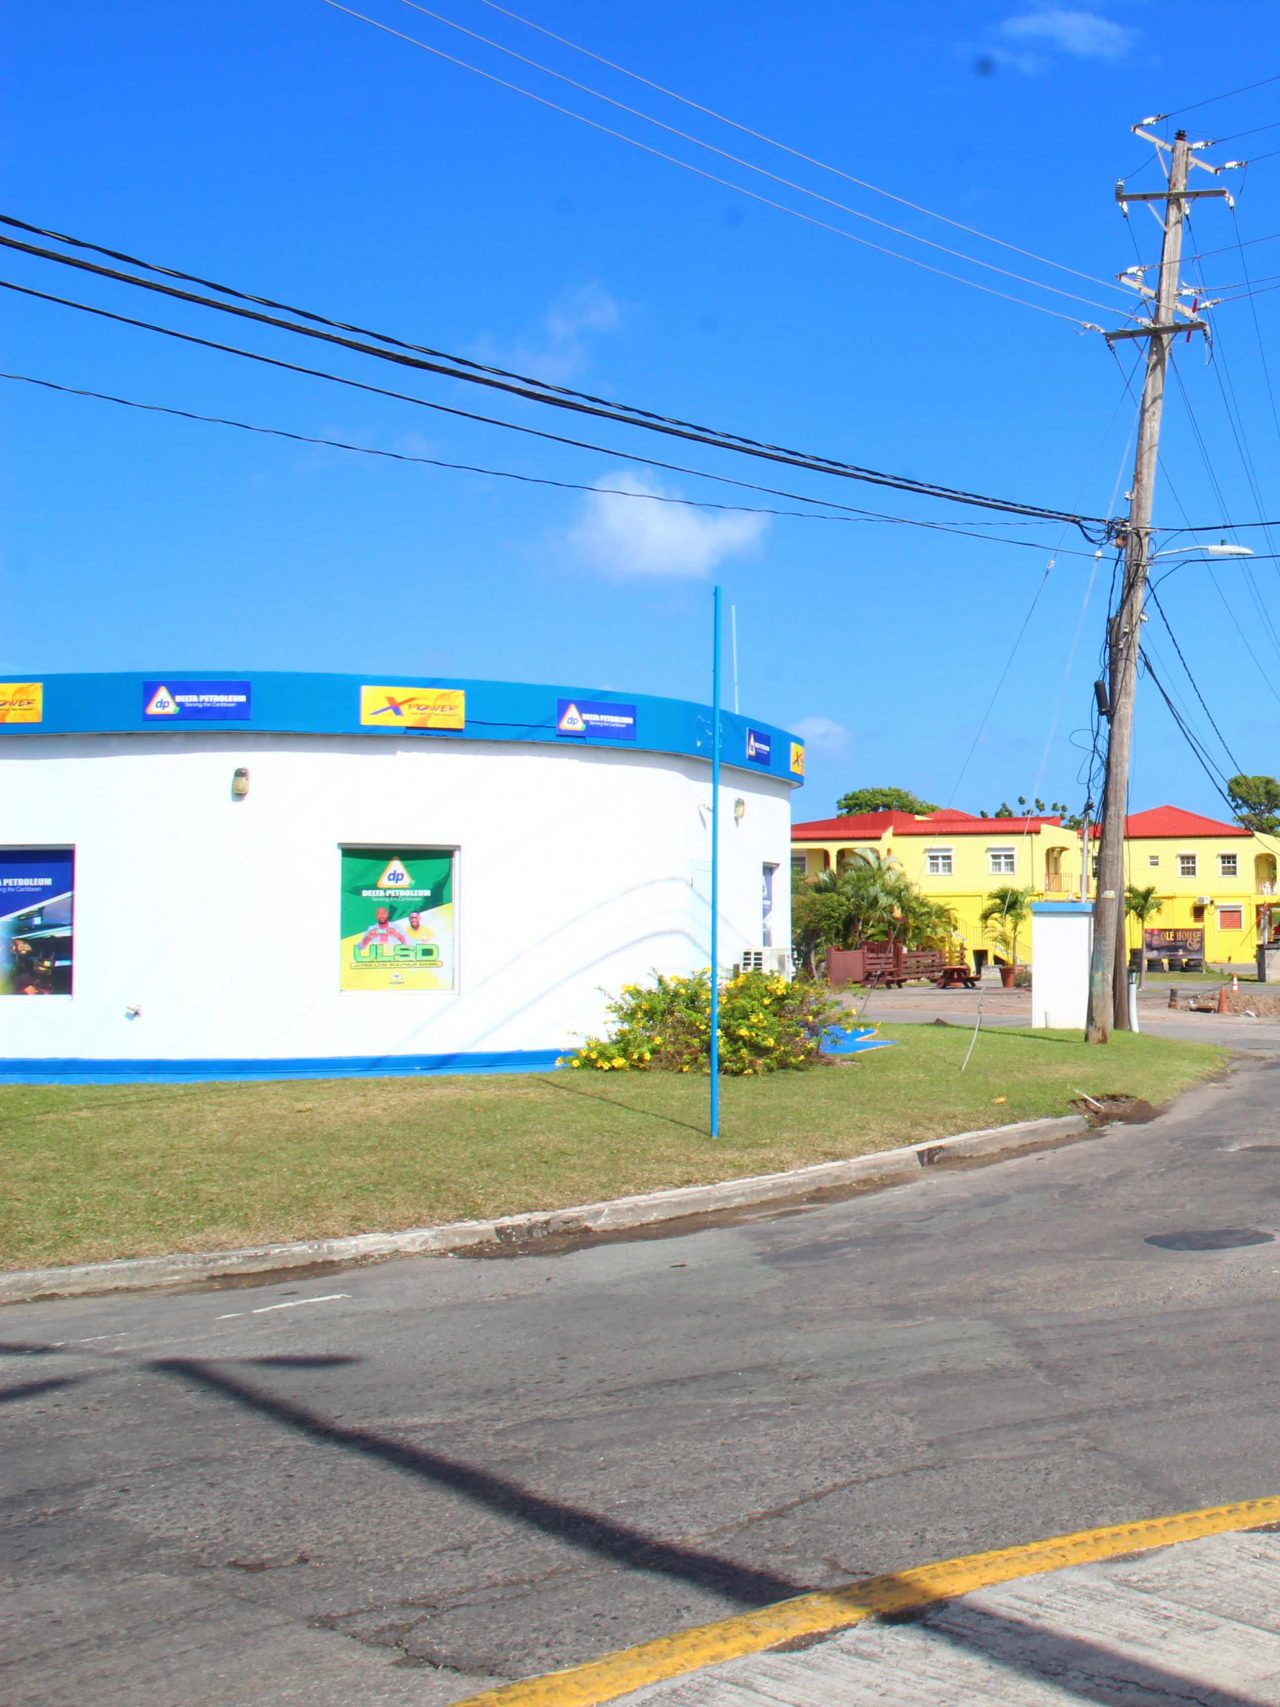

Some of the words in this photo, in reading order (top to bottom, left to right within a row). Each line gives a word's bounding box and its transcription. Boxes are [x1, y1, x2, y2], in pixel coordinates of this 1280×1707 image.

[155, 699, 170, 710] dp
[3, 878, 52, 886] PETROLEUM
[387, 870, 405, 884] dp
[361, 889, 385, 897] DELTA
[385, 889, 431, 897] PETROLEUM
[353, 943, 440, 962] ULSD
